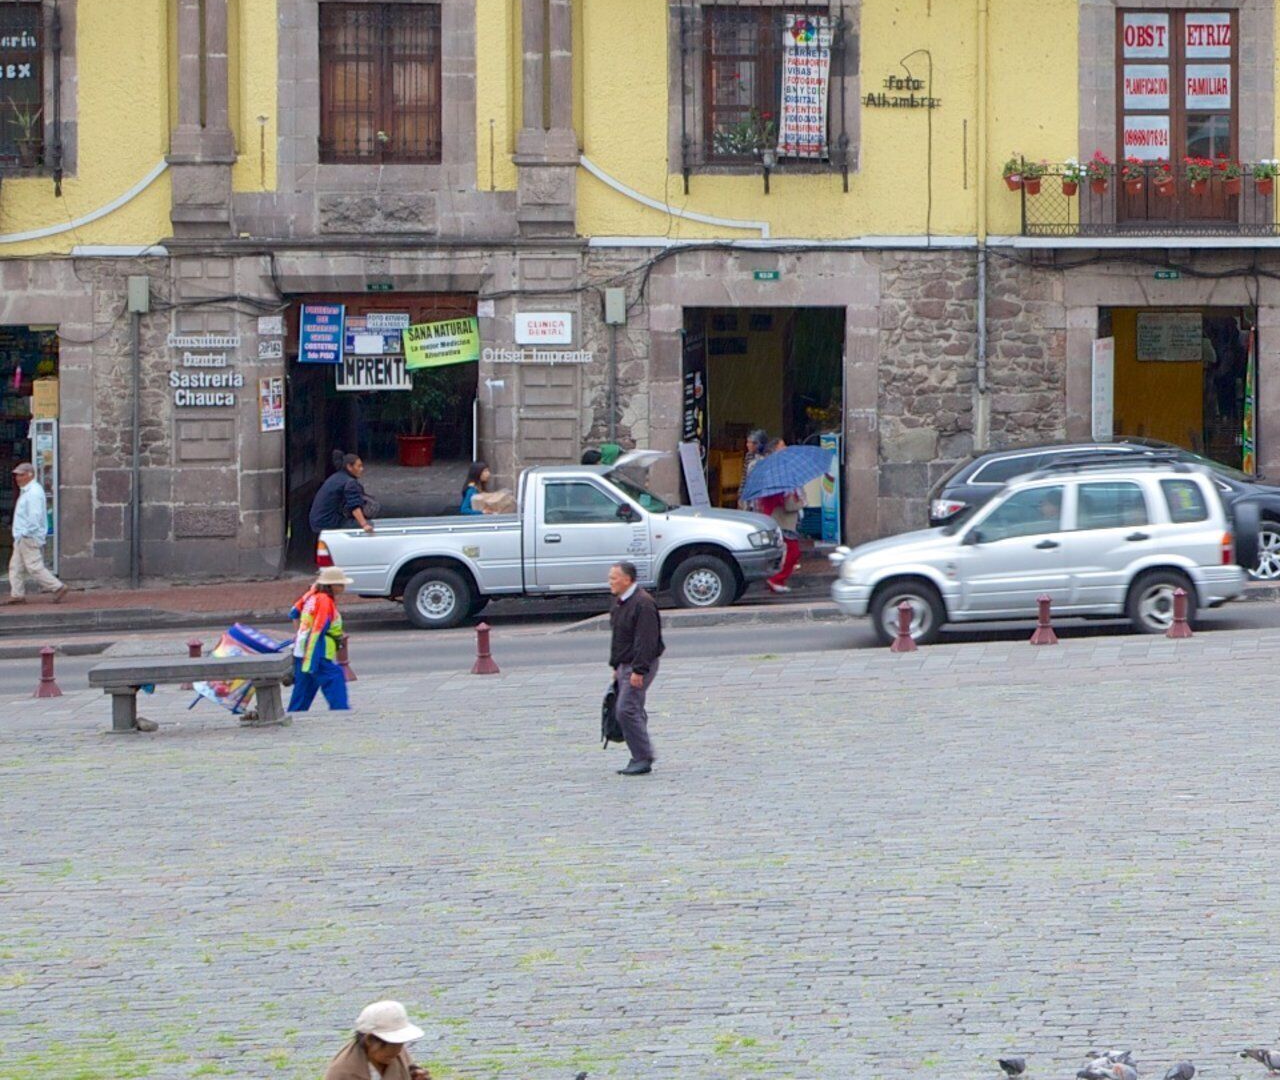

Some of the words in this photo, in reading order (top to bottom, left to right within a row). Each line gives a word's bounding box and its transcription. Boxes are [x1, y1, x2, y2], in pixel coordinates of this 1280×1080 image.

[1124, 24, 1166, 47] OBST
[1187, 23, 1231, 46] ETRIZ
[888, 75, 920, 91] Foto
[1125, 78, 1168, 96] PLANIFICACION
[1187, 78, 1229, 96] FAMILIAR
[866, 92, 936, 110] Alhambra
[408, 325, 433, 341] SANA
[433, 320, 473, 337] NATURAL
[482, 348, 525, 362] Offset
[533, 348, 592, 366] Imprenta
[169, 371, 243, 387] Sastrería
[174, 389, 235, 406] Chauca
